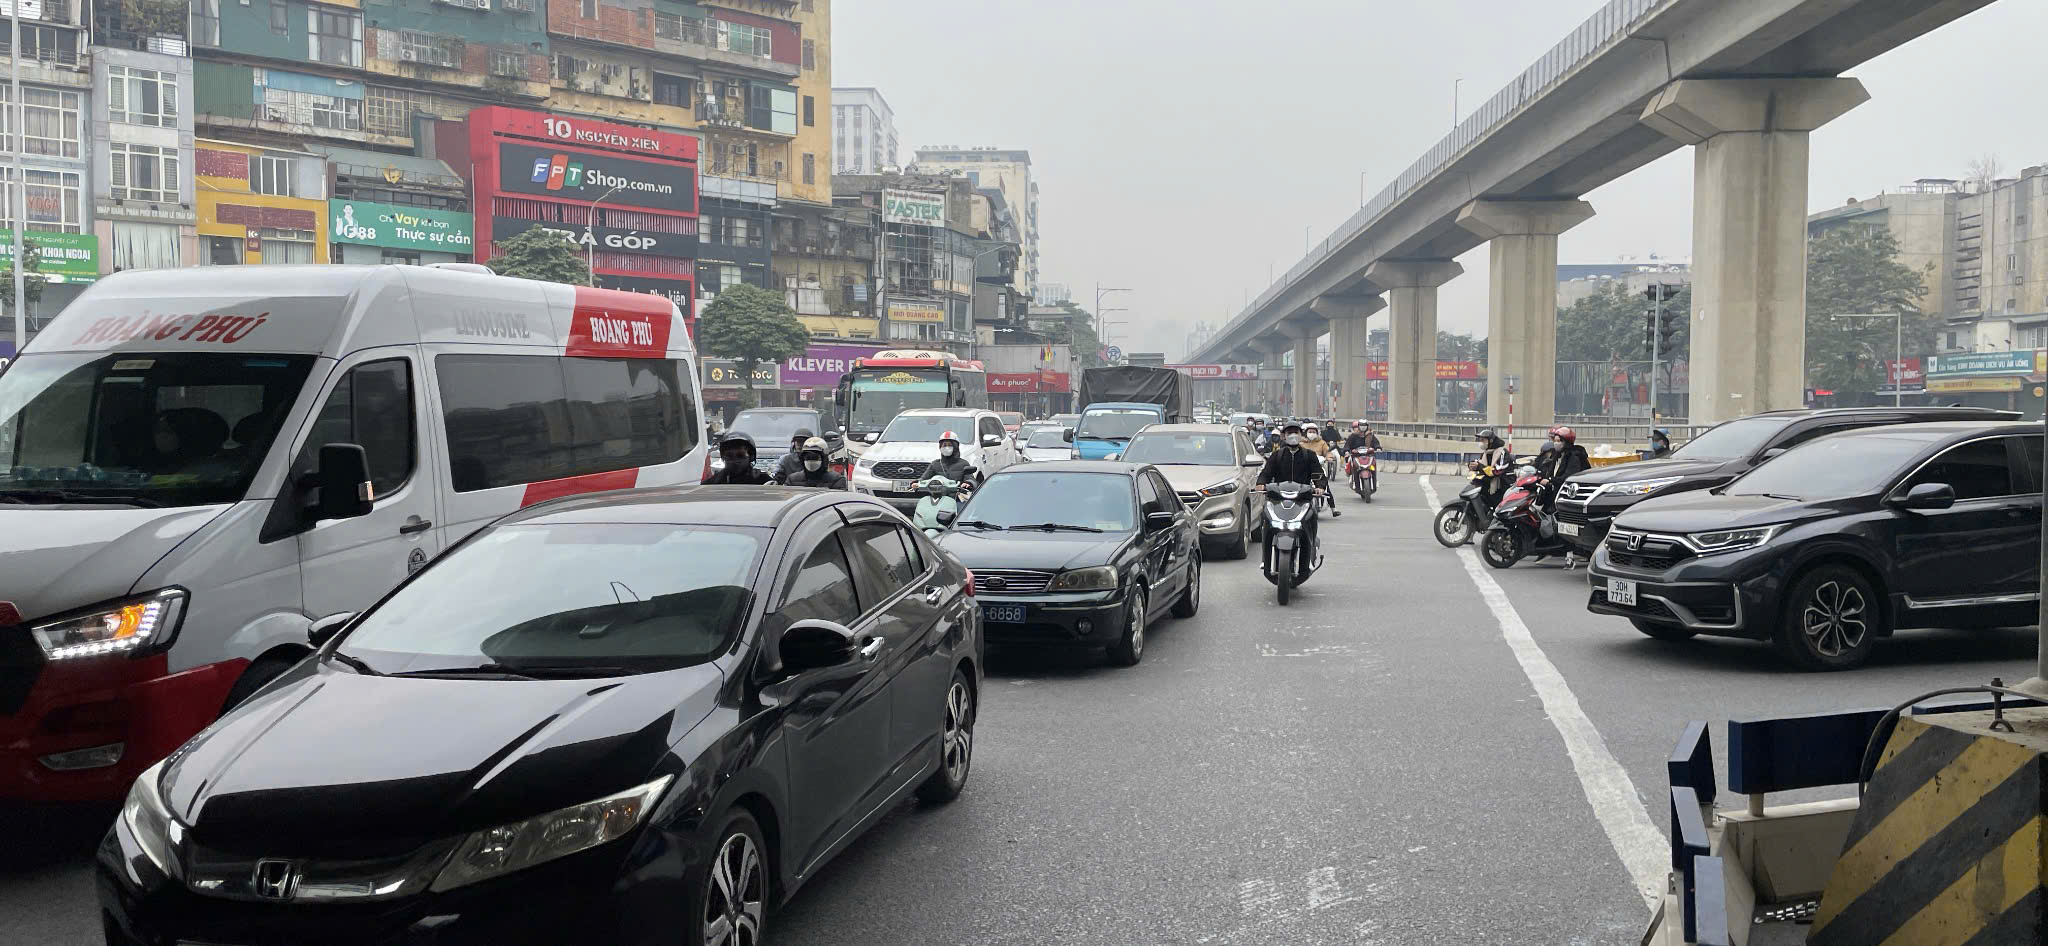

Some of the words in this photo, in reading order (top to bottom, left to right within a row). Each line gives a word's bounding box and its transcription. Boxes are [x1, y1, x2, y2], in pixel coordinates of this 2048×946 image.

[543, 118, 572, 138] 10
[533, 163, 582, 182] FPT
[586, 169, 672, 194] Shop.com.vn
[887, 200, 941, 220] FASTER
[394, 213, 419, 227] Vay
[433, 219, 450, 230] bạn
[395, 227, 426, 243] Thực
[429, 231, 444, 245] sự
[604, 230, 657, 250] GÓP
[42, 246, 65, 259] KHOA
[65, 248, 91, 262] NGOẠI
[72, 310, 194, 346] HOÀNG
[178, 311, 270, 344] PHÚ
[454, 311, 531, 339] LIMOUSINE
[590, 311, 630, 344] HOÀNG
[788, 357, 845, 372] KLEVER
[1615, 581, 1628, 592] 30H
[1610, 590, 1633, 604] 773.64
